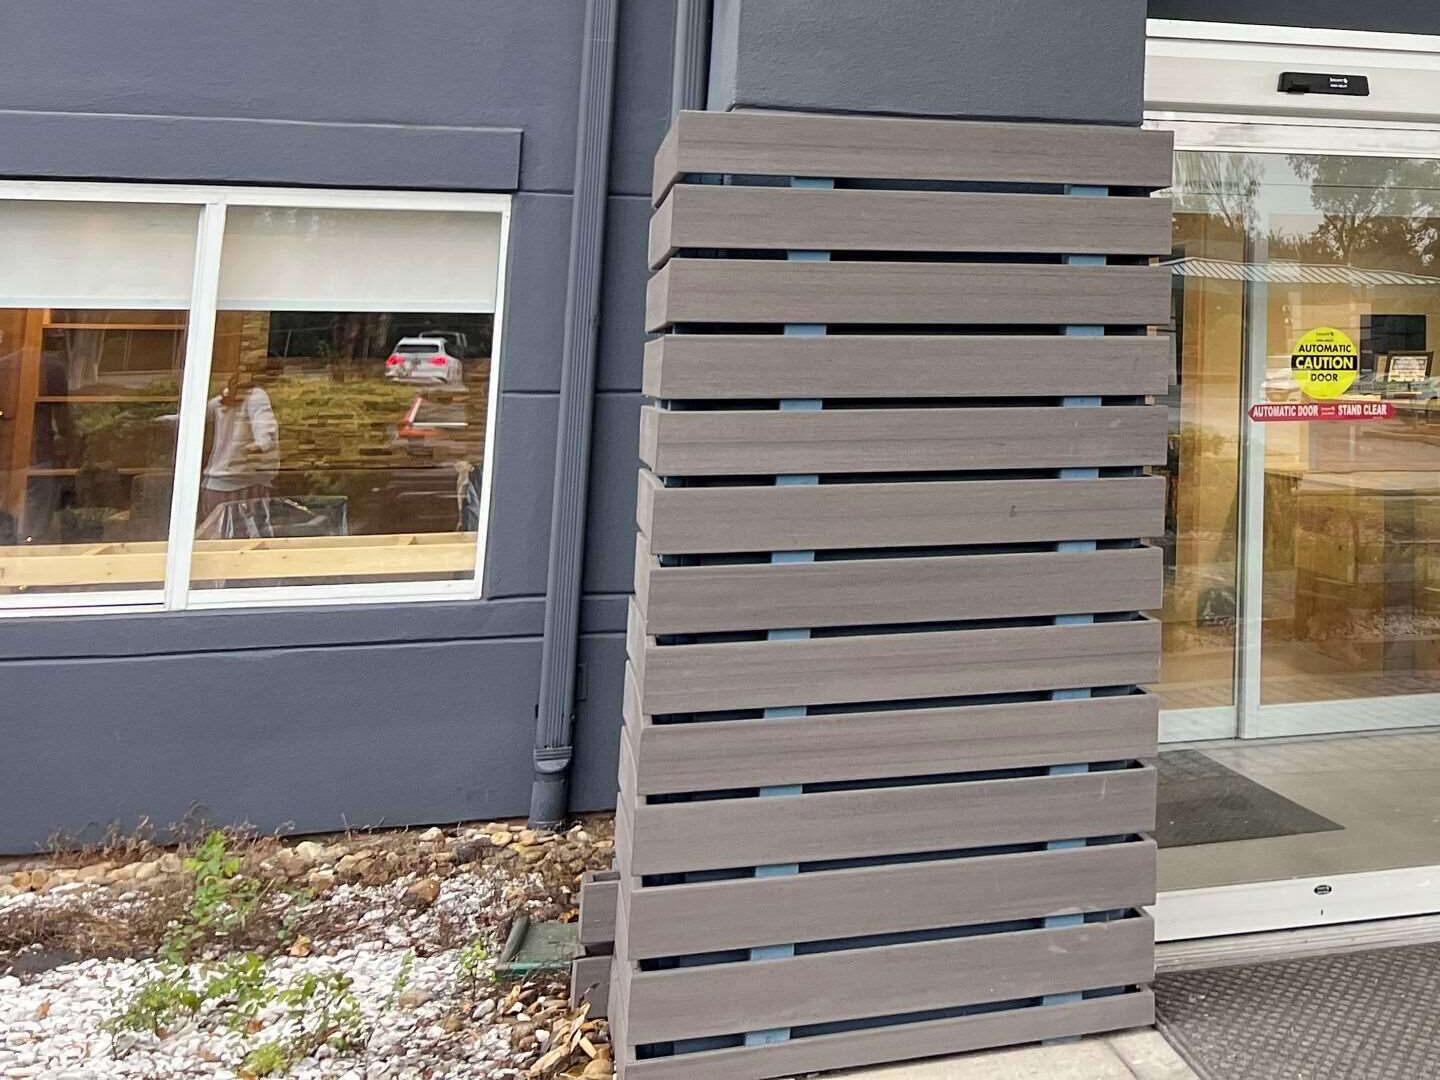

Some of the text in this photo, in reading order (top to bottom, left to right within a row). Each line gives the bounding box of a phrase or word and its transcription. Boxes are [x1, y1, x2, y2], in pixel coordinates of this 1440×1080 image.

[1299, 344, 1351, 353] AUTOMATIC
[1295, 356, 1353, 369] CAUTION
[1311, 373, 1338, 382] DOOR
[1253, 404, 1297, 417] AUTOMATIC
[1298, 404, 1318, 416] DOOR
[1338, 404, 1361, 415] STAND
[1363, 403, 1387, 415] CLEAR
